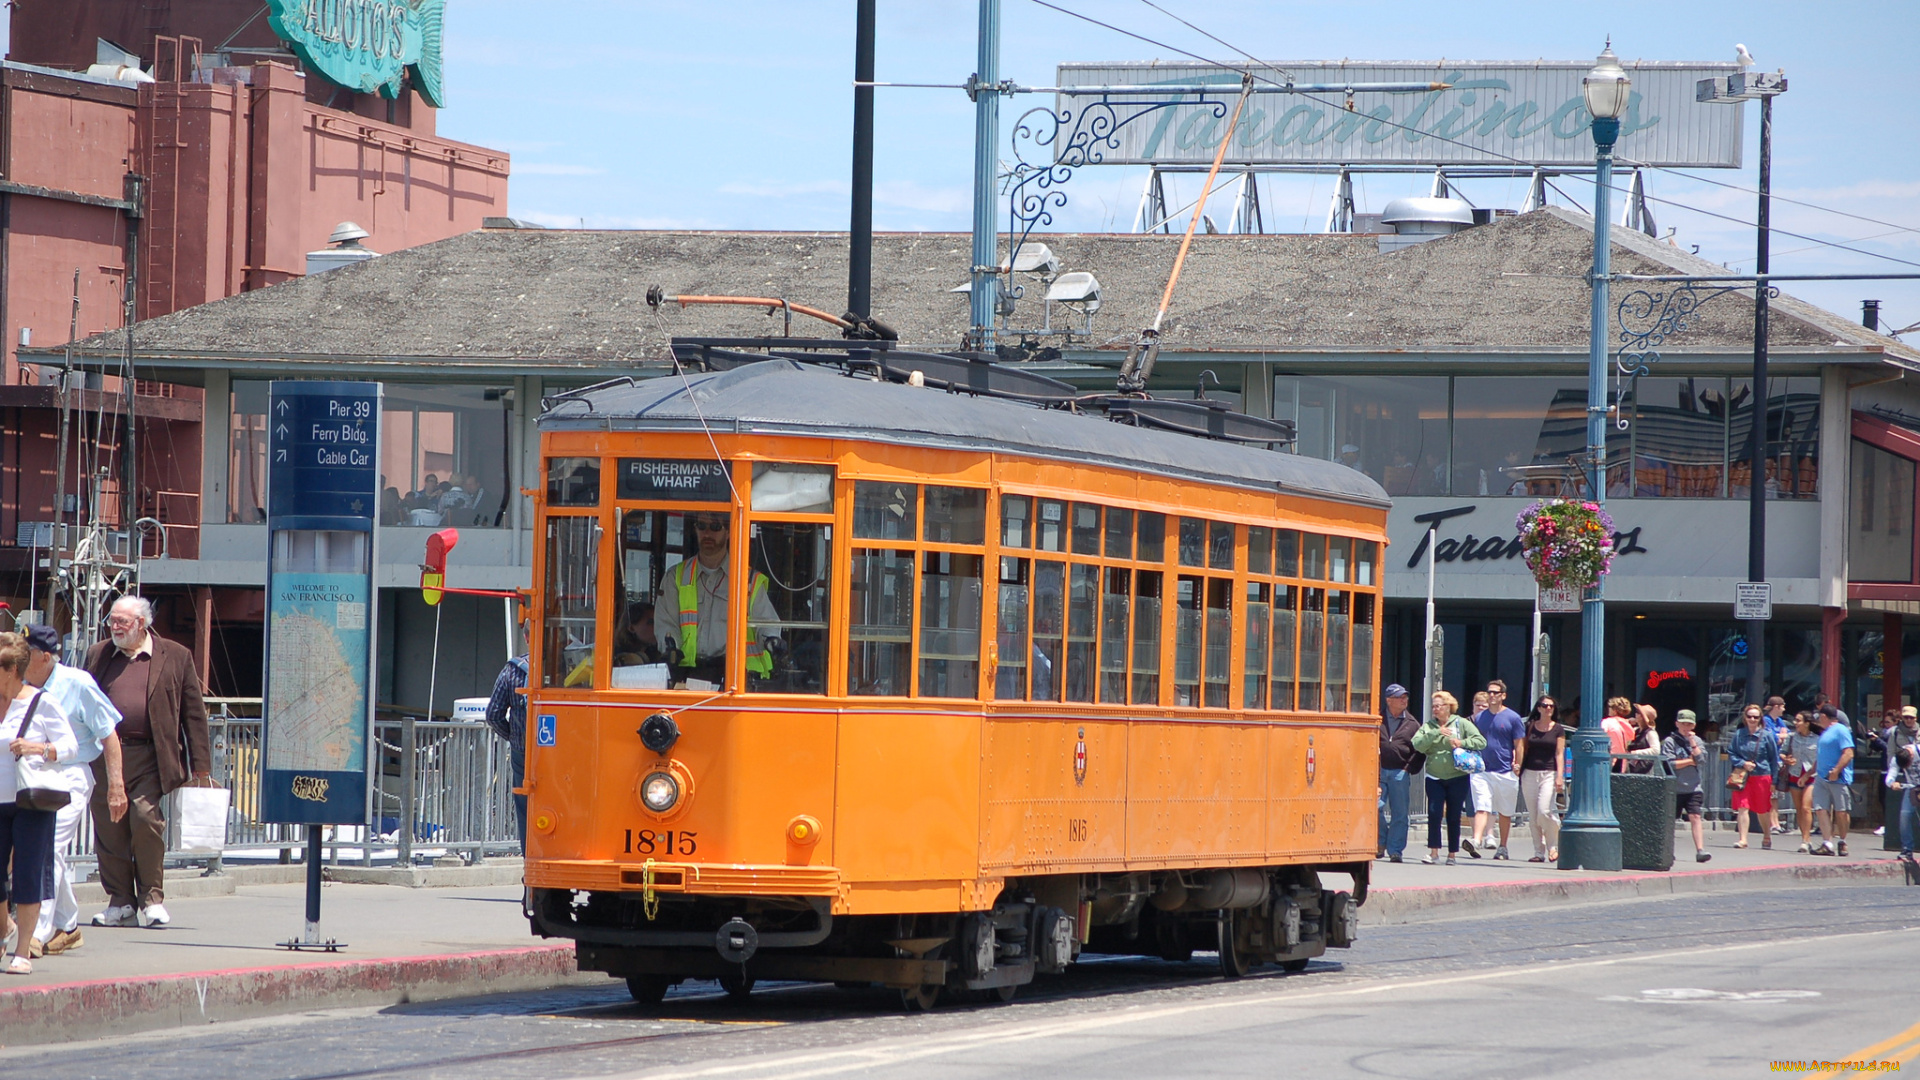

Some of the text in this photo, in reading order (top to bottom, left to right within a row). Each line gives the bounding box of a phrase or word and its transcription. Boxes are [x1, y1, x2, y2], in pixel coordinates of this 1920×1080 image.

[329, 400, 370, 418] Pier 39
[312, 424, 369, 444] Ferry Bldg.
[317, 447, 369, 465] Cable Car
[630, 462, 723, 476] FISHERMAN'S
[651, 475, 701, 488] WHARF
[281, 592, 355, 602] SAN FRANCISCO
[292, 584, 339, 592] WELCOME TO
[1550, 592, 1571, 602] TIME
[1068, 818, 1088, 842] 1815
[1301, 813, 1316, 835] 1815
[623, 828, 698, 856] 1815
